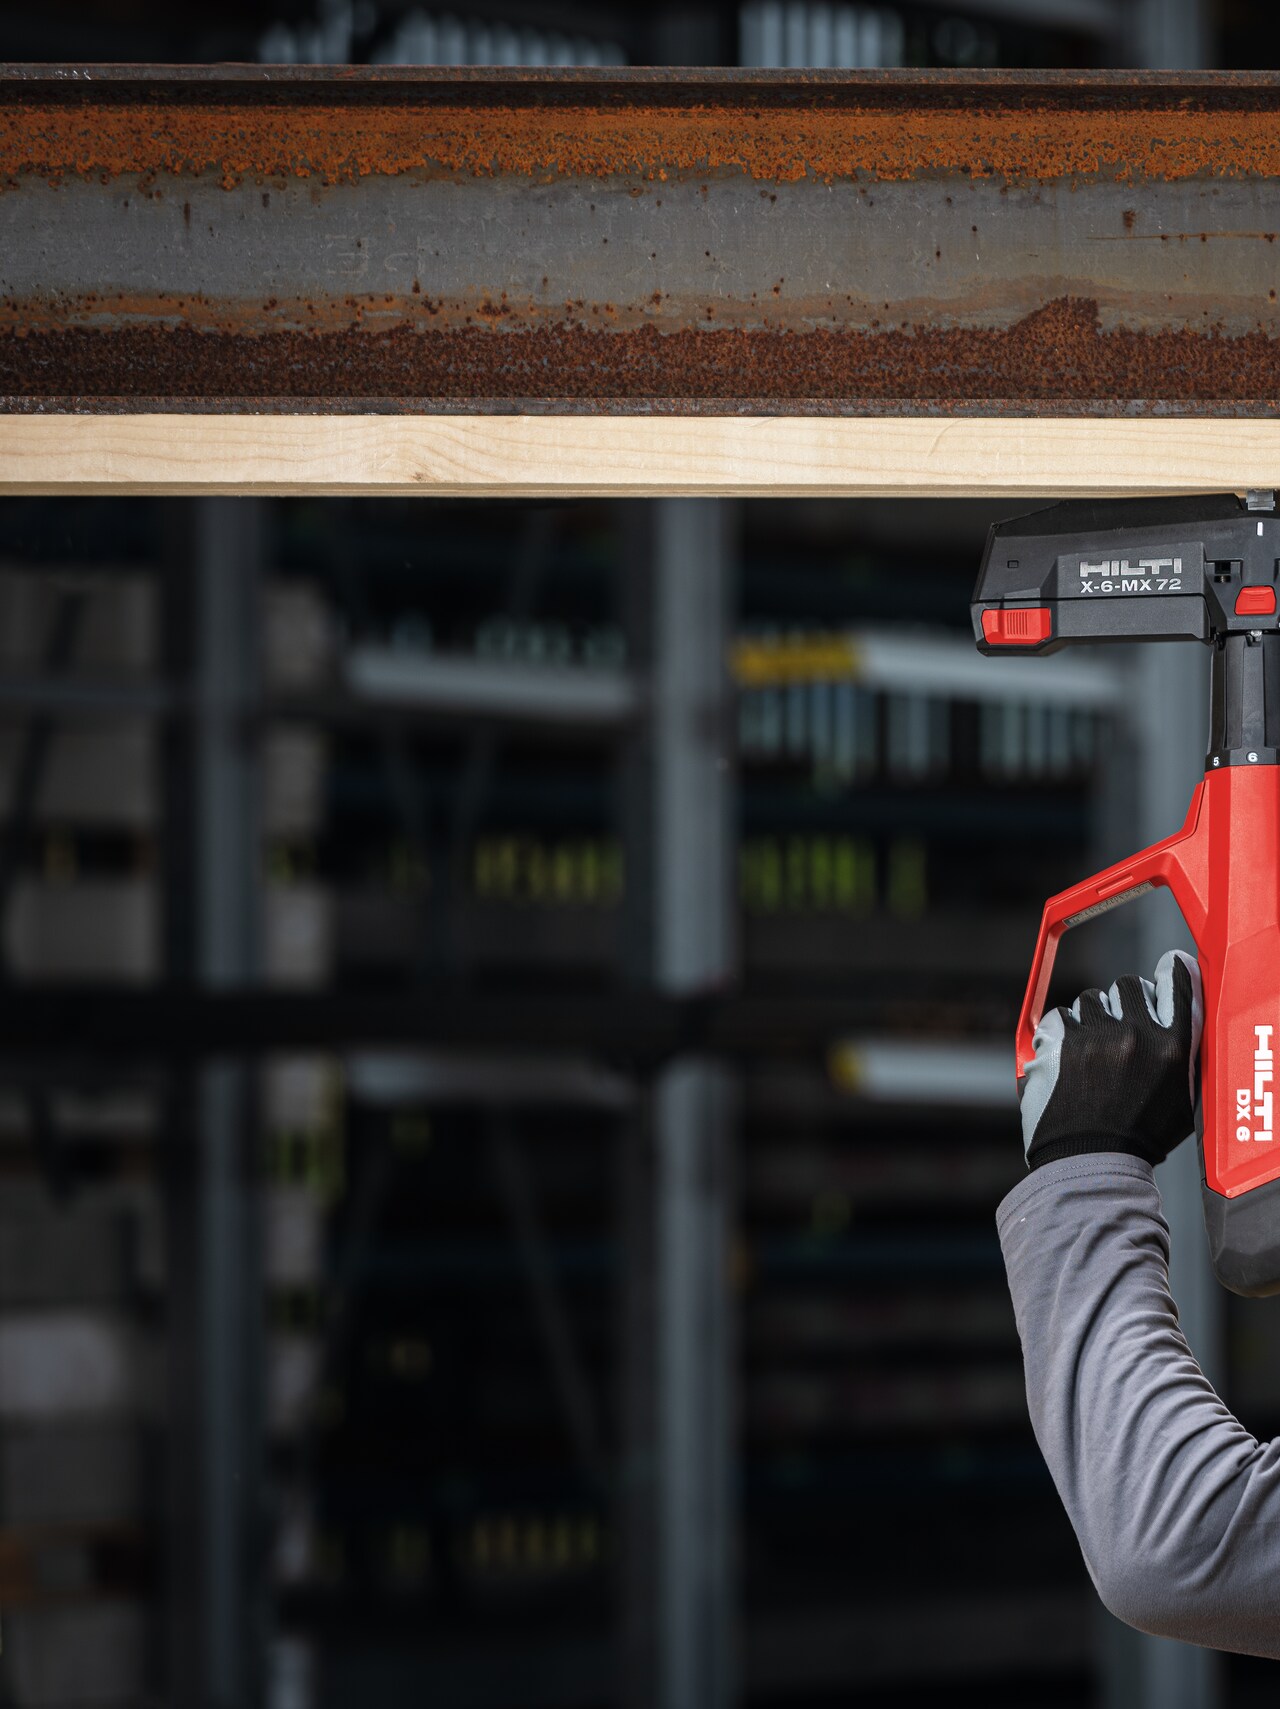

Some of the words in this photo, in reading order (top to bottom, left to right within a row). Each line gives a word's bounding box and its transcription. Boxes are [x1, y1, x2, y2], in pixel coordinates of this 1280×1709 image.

[1080, 558, 1182, 577] HILTI
[1080, 579, 1152, 593] X-6-MX
[1155, 578, 1182, 591] 72
[1212, 756, 1221, 767] 5
[1248, 752, 1259, 763] 6
[1254, 1025, 1273, 1141] HILTI
[1236, 1089, 1251, 1120] DX
[1236, 1126, 1250, 1142] 6
